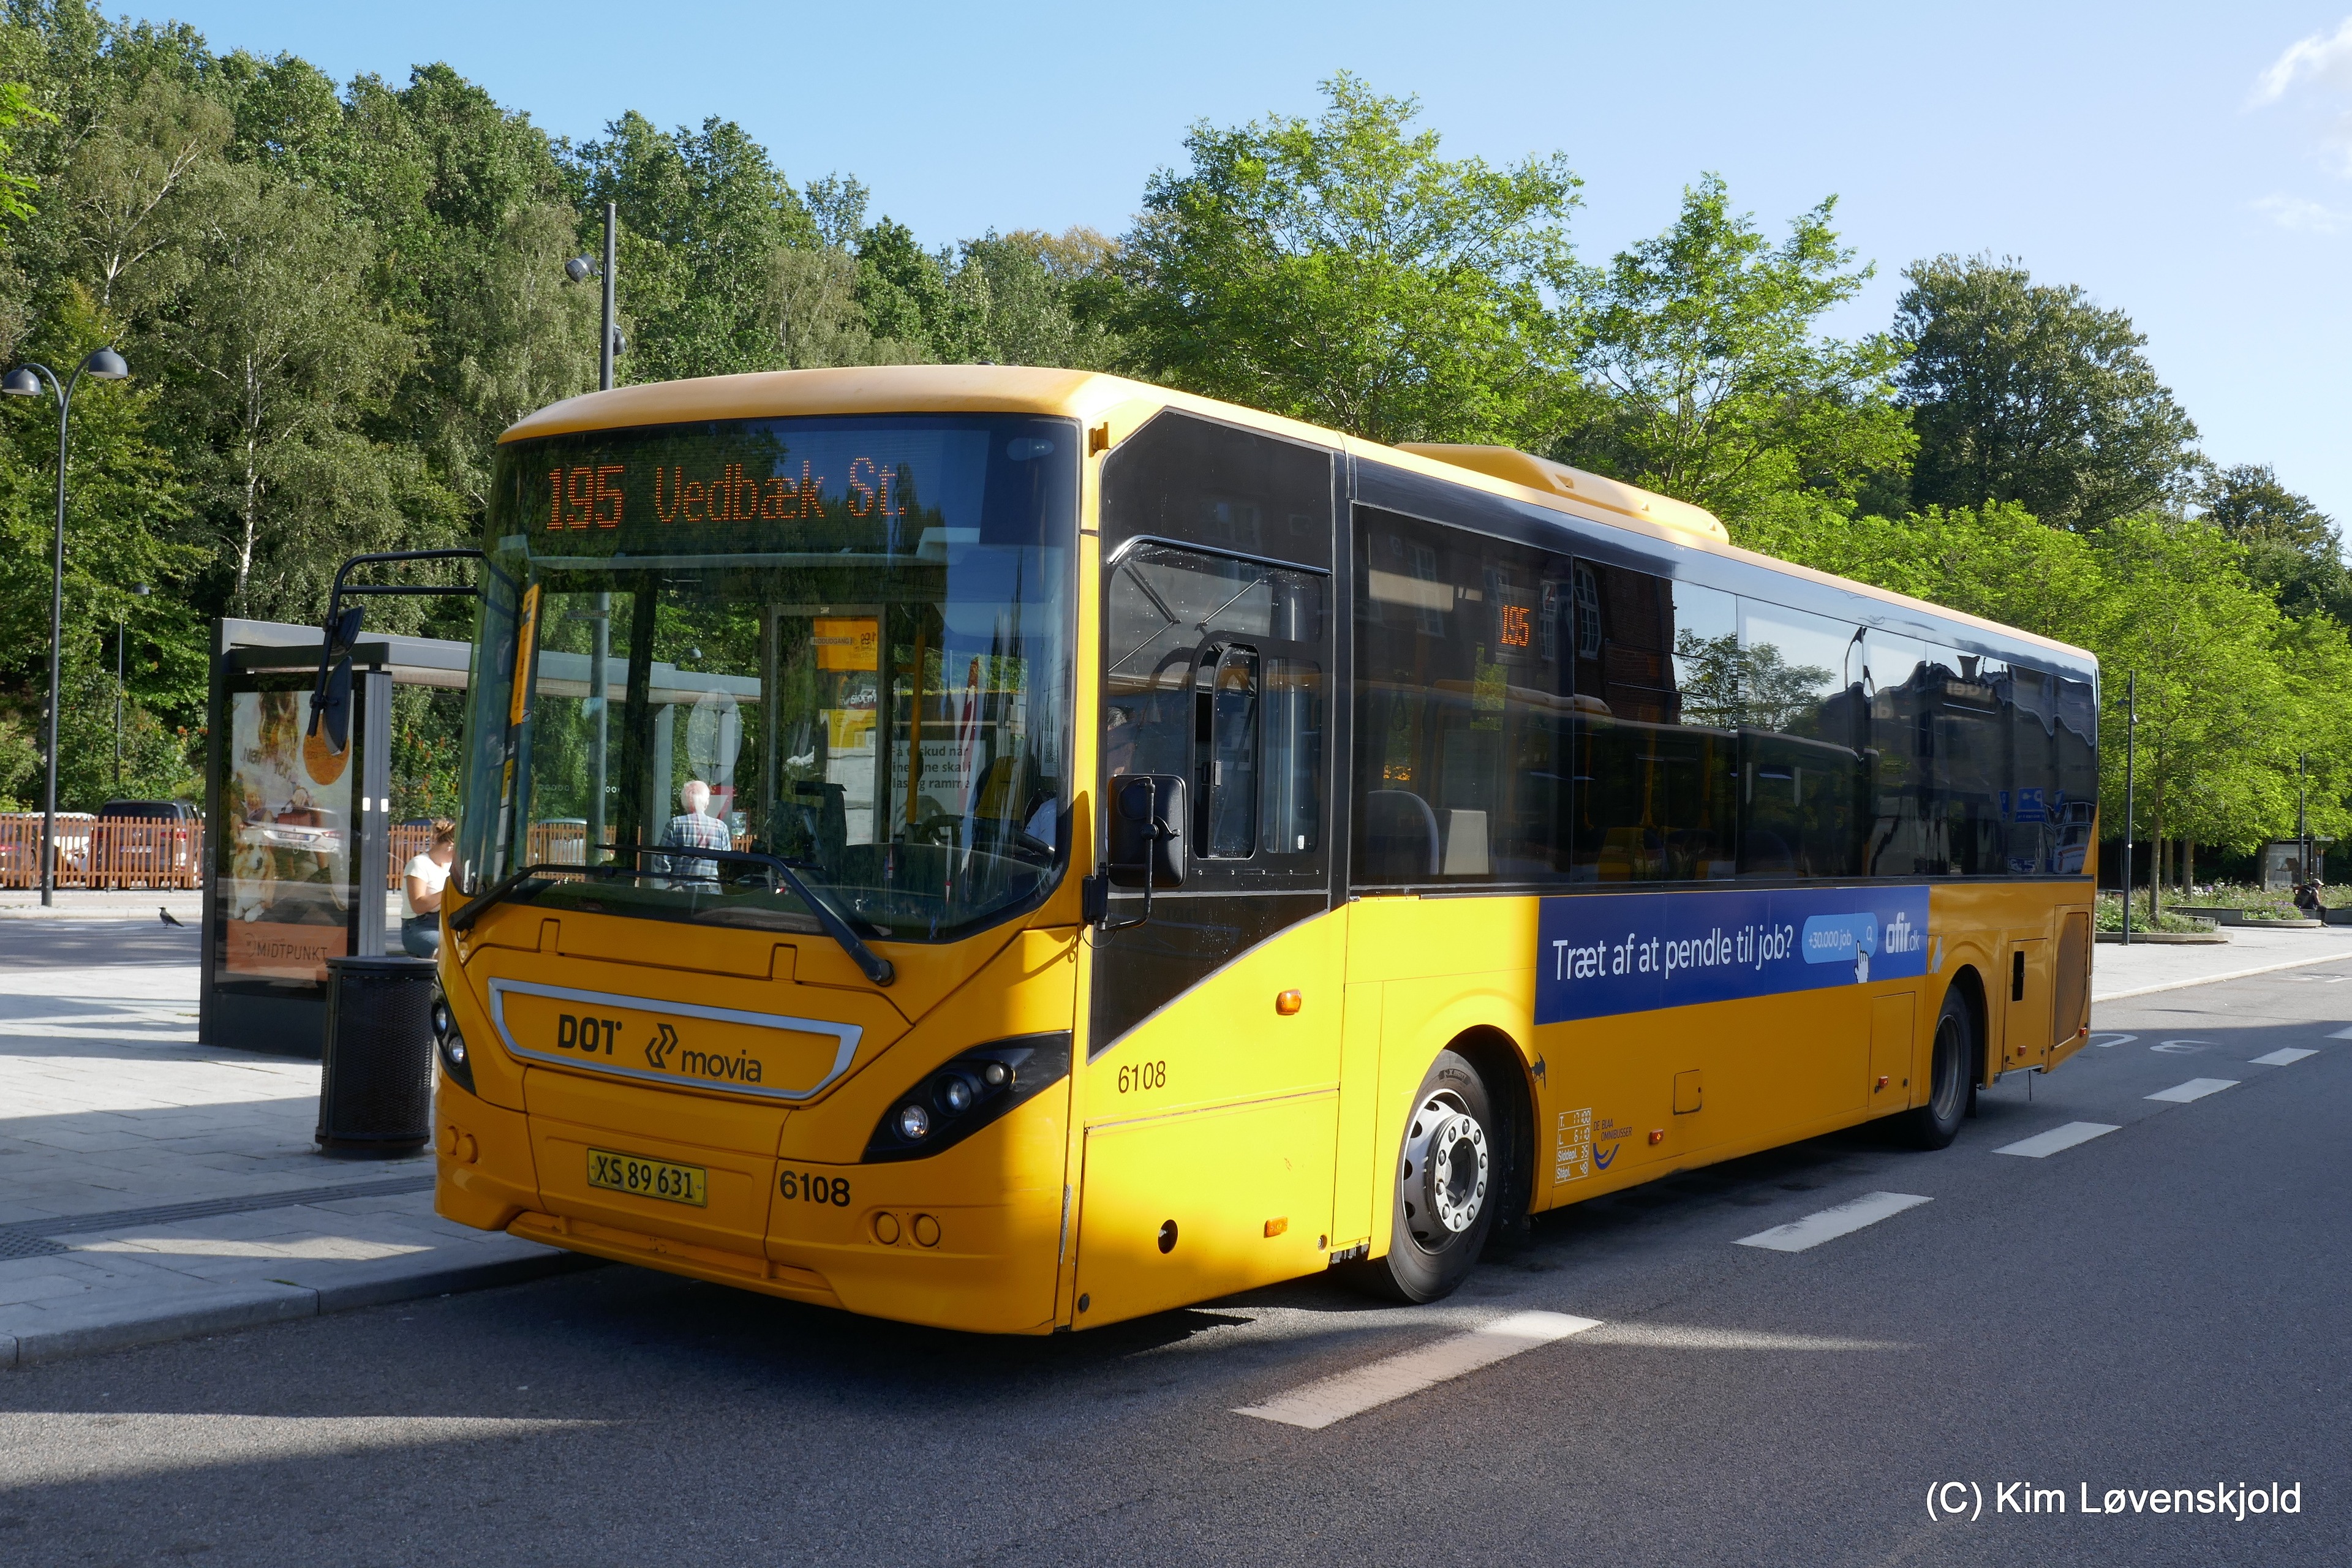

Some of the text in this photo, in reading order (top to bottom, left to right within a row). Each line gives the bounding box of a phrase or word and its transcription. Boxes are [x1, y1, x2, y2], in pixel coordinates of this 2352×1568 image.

[546, 465, 625, 529] 195
[849, 456, 905, 518] St.
[1501, 605, 1529, 646] 195
[907, 745, 946, 756] tskud
[1808, 930, 1852, 949] +30.000 job
[1885, 911, 1920, 954] ofir.dk
[257, 941, 327, 961] MIDTPUNKT
[1553, 924, 1794, 981] Træt af at pendle til job?
[557, 1014, 622, 1055] DOT
[681, 1049, 762, 1083] movia
[1118, 1060, 1166, 1093] 6108
[1593, 1121, 1600, 1131] DE
[1601, 1127, 1632, 1141] OMNIBUSSER
[1558, 1147, 1577, 1163] Siddepl.
[595, 1155, 694, 1199] XS 89 631
[780, 1169, 851, 1208] 6108
